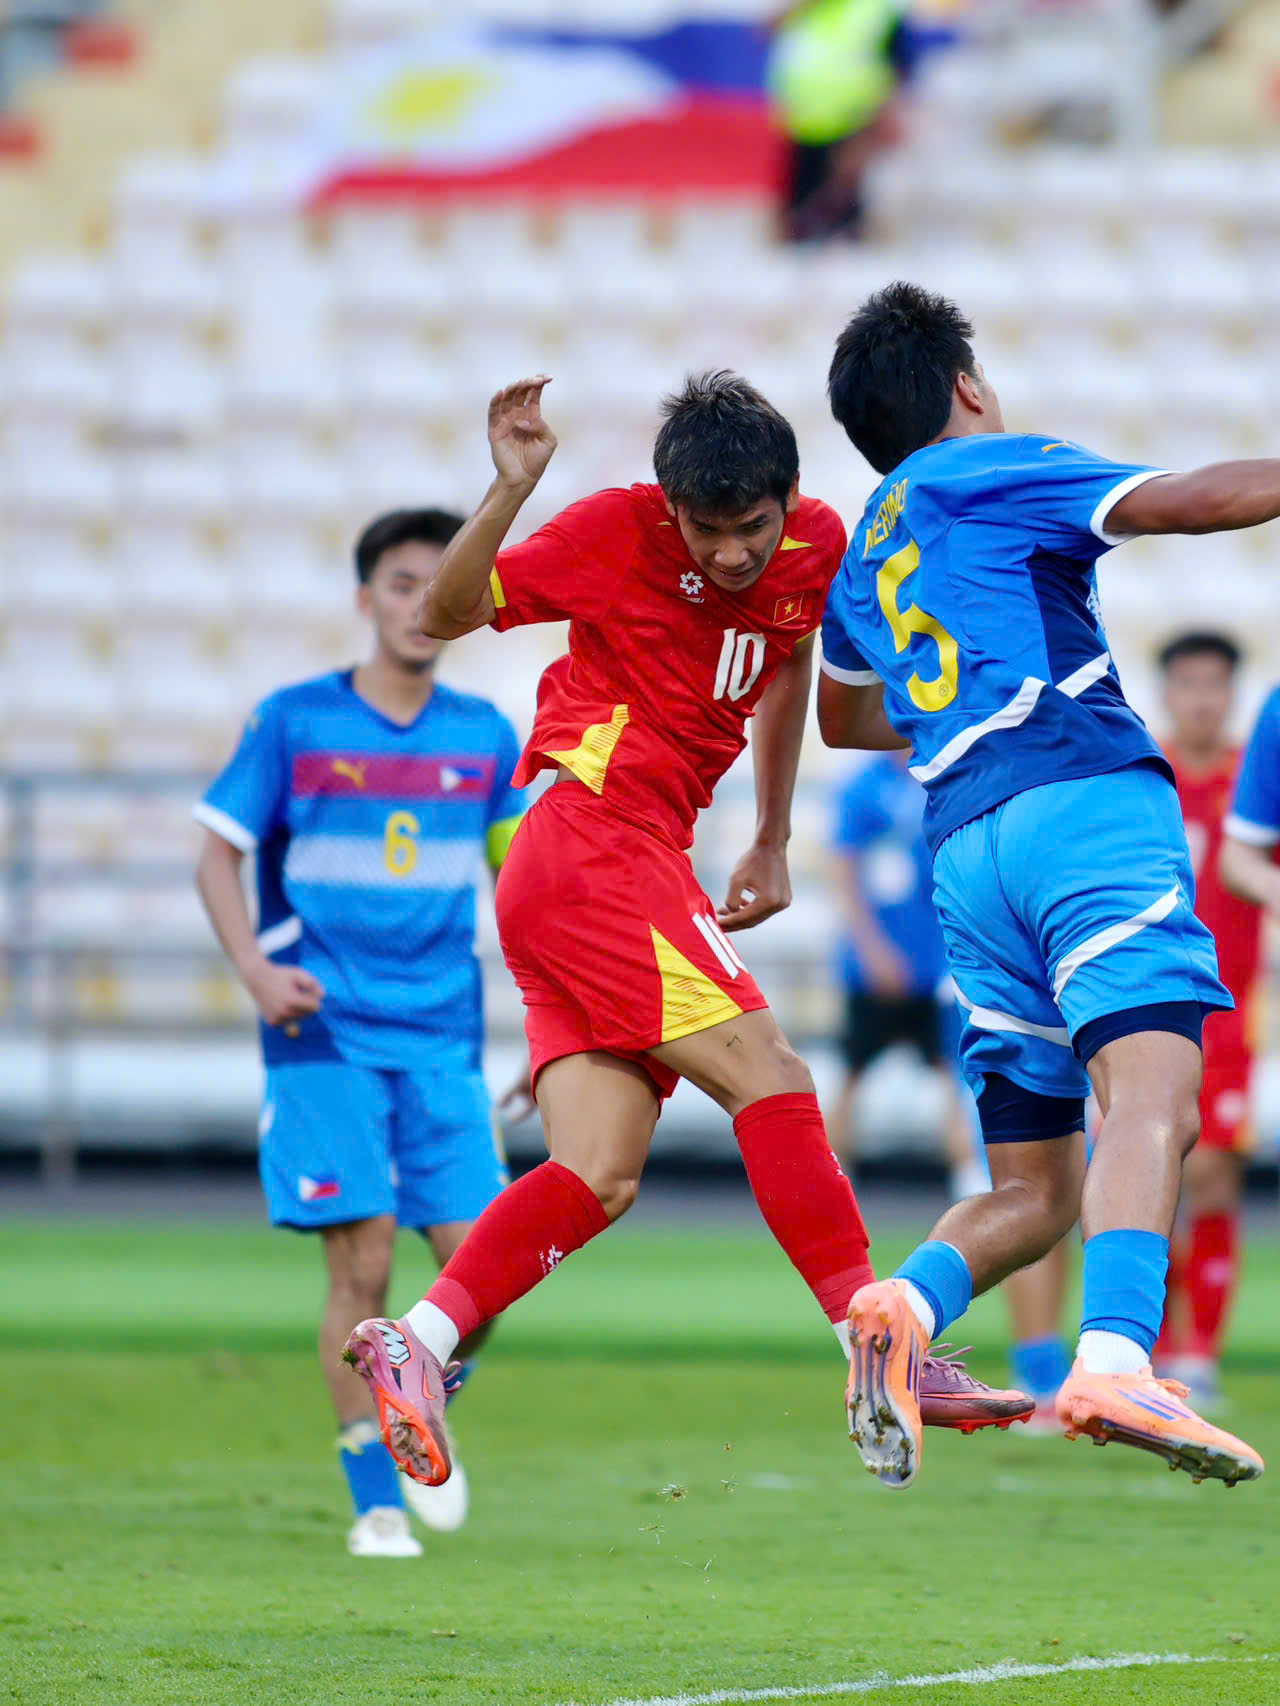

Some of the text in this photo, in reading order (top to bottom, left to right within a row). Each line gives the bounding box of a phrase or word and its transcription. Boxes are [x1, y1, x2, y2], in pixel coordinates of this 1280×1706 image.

[876, 538, 959, 713] 5
[713, 628, 767, 702] 10
[384, 811, 421, 878] 6
